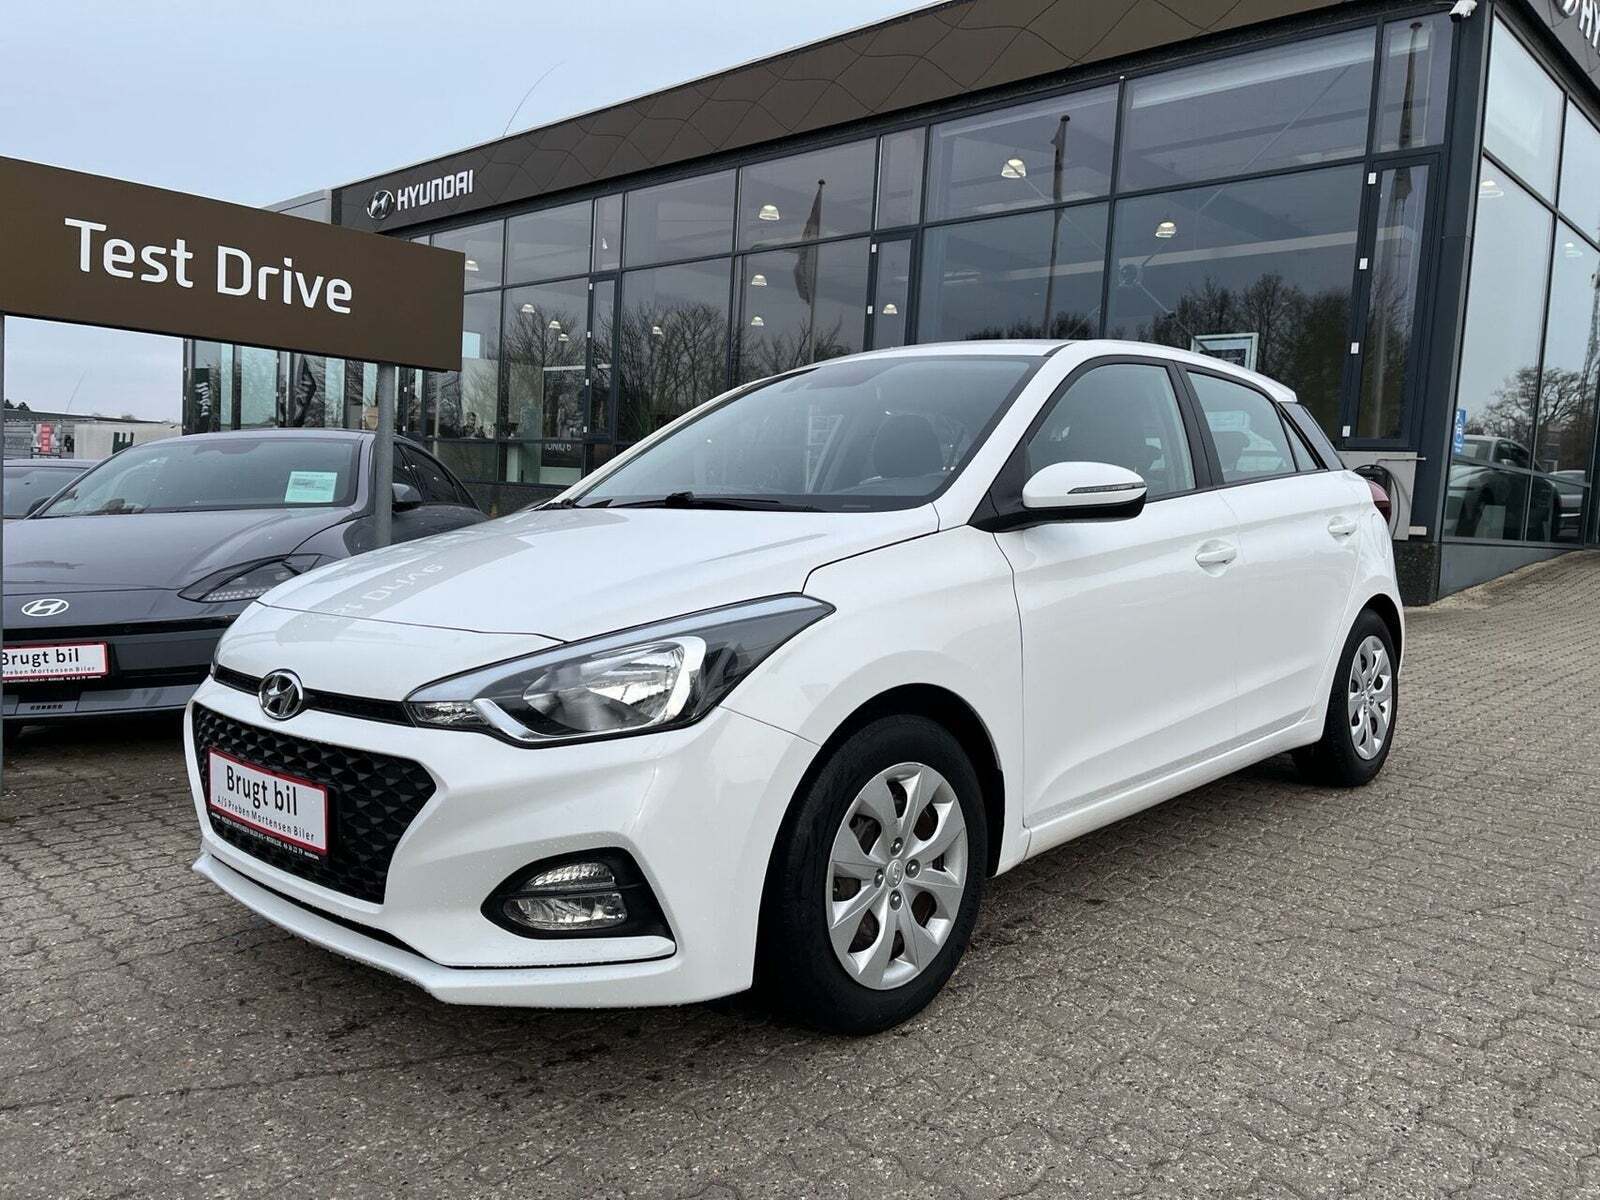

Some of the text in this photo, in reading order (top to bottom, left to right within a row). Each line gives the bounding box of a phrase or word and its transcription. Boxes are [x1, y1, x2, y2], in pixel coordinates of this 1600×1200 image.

[396, 168, 474, 211] HYUNDAI
[64, 217, 353, 315] Test Drive
[2, 647, 79, 668] Brugt bil
[75, 665, 96, 673] Biler
[226, 765, 298, 816] Brugt bil
[228, 800, 250, 817] Preben
[251, 811, 291, 835] Mortensen
[293, 825, 315, 842] Biler
